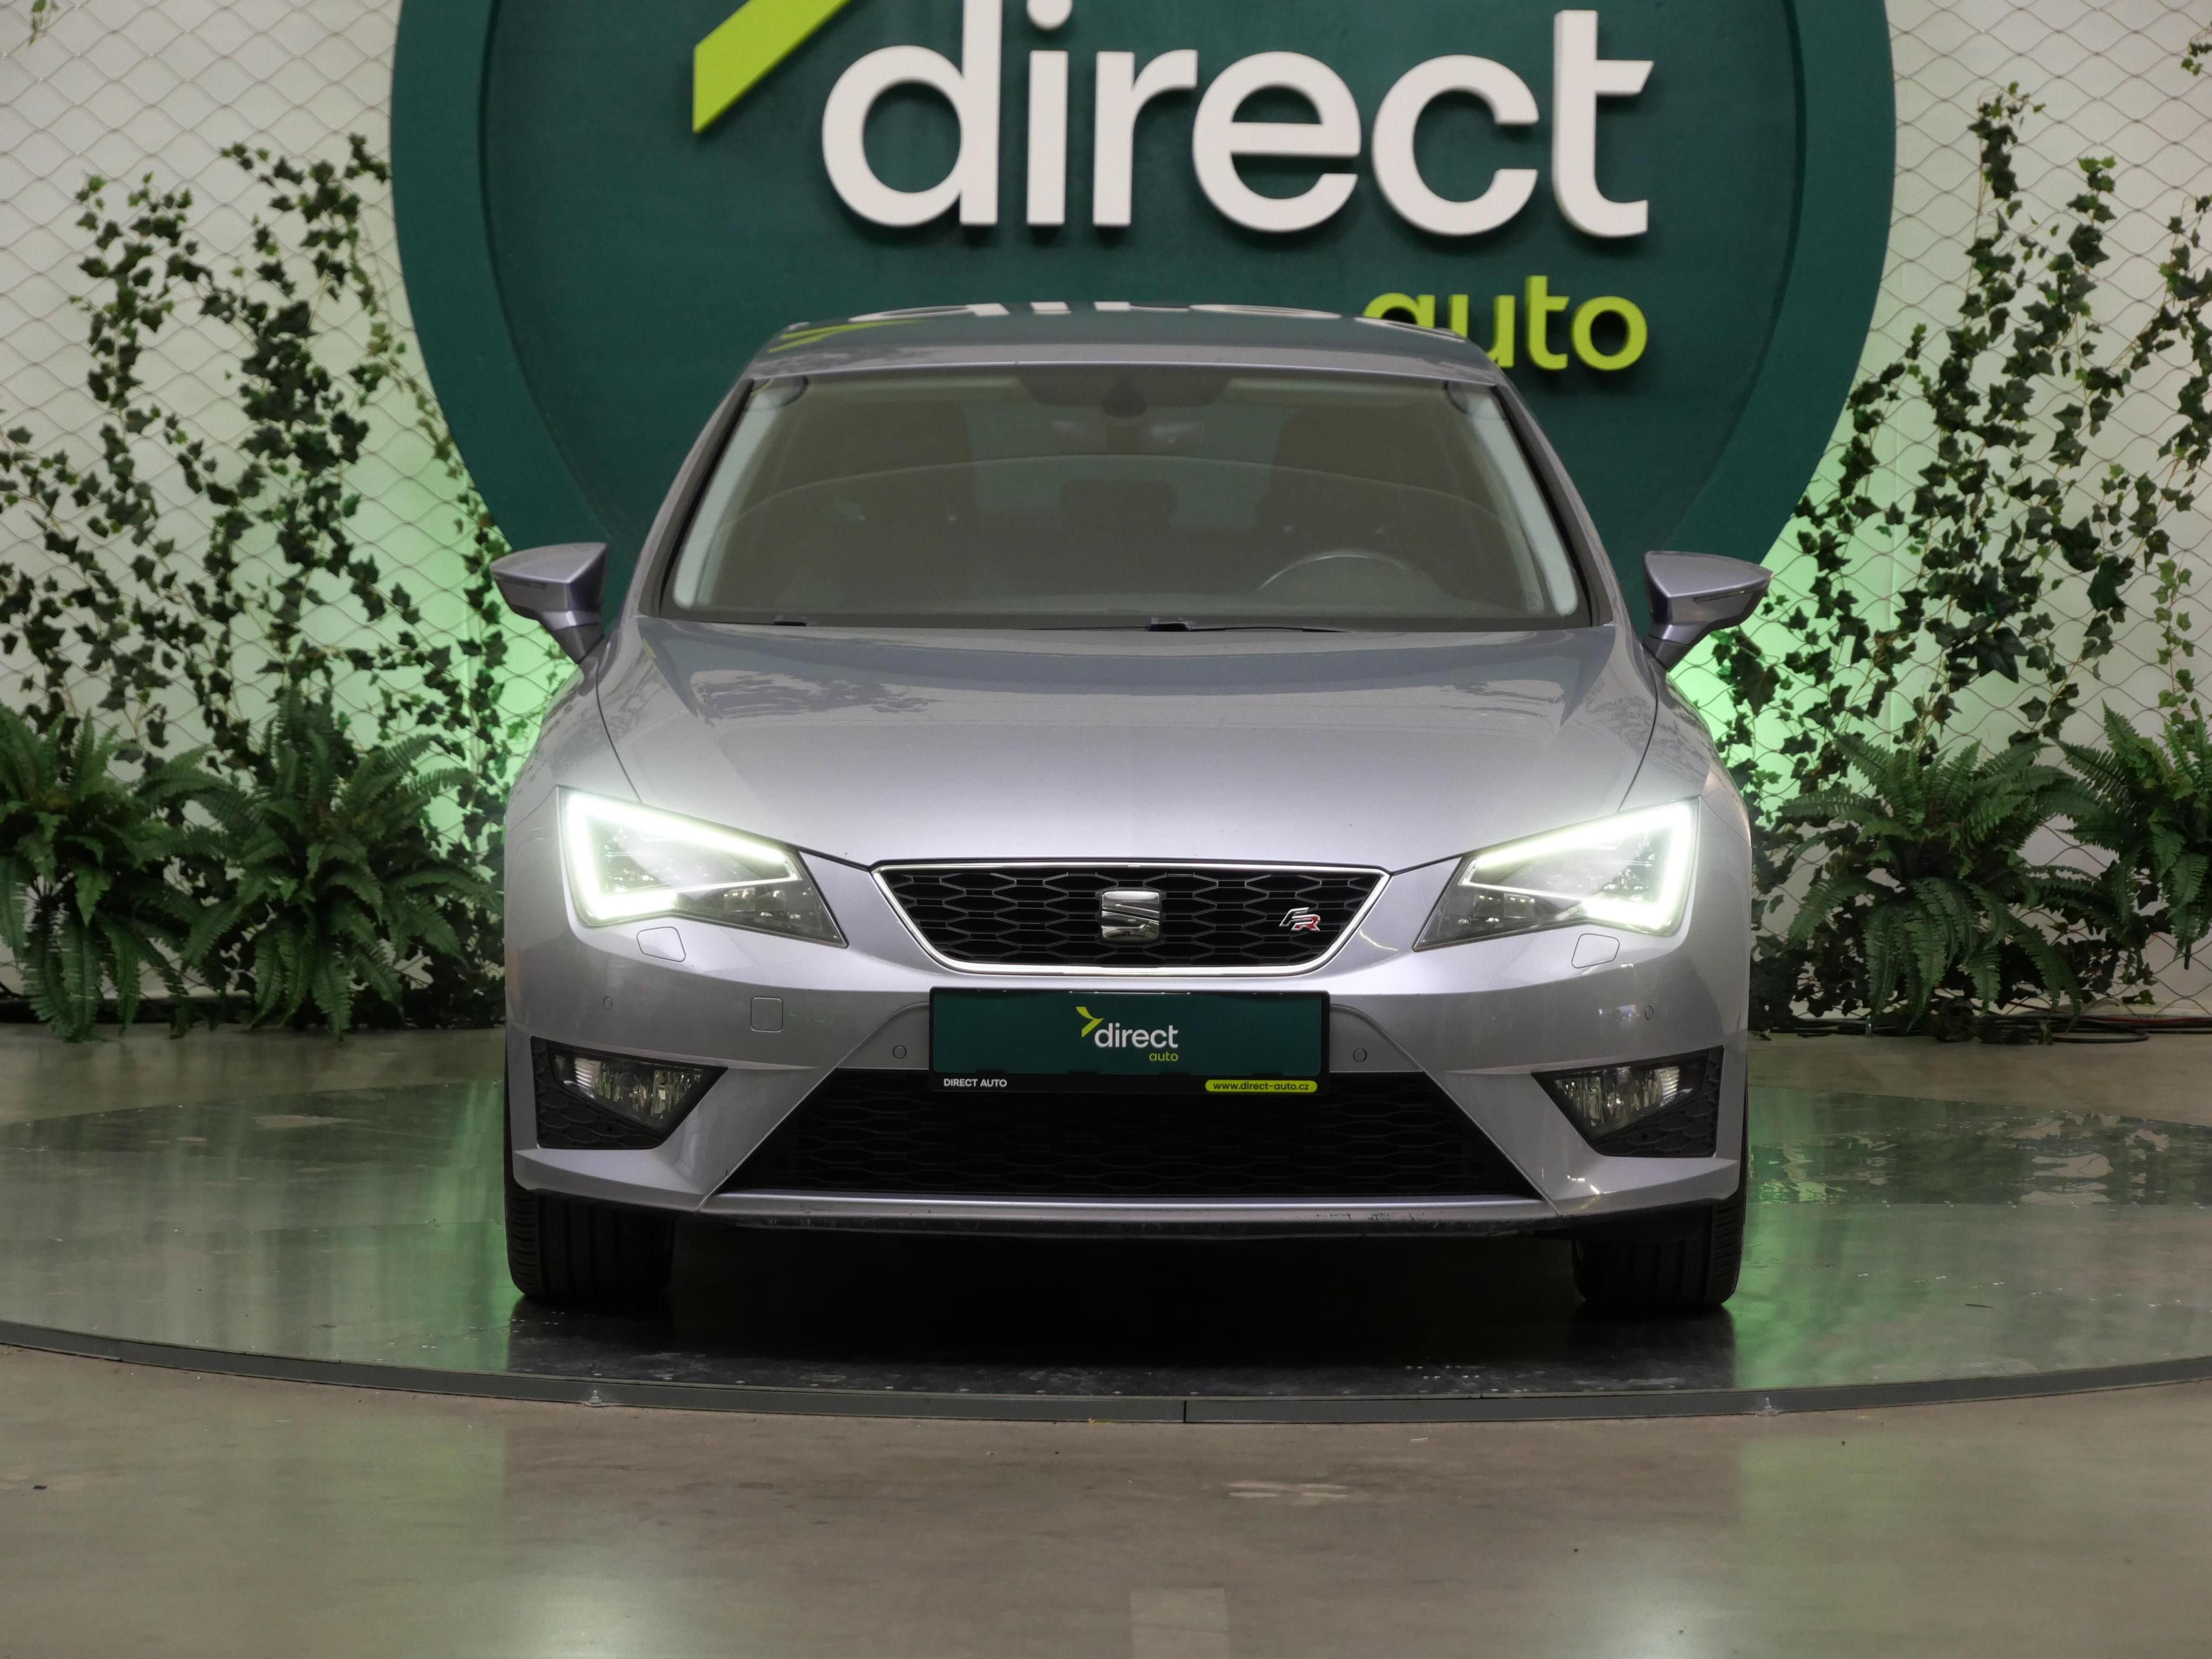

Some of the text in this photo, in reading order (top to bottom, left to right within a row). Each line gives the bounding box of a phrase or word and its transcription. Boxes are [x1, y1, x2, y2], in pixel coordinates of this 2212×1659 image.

[821, 0, 1654, 239] direct
[1279, 907, 1321, 931] FR
[1094, 1022, 1178, 1048] direct
[1149, 1051, 1178, 1062] auto
[943, 1078, 1008, 1088] DIRECT AUTO
[1213, 1081, 1309, 1091] www.direct-auto.cz
